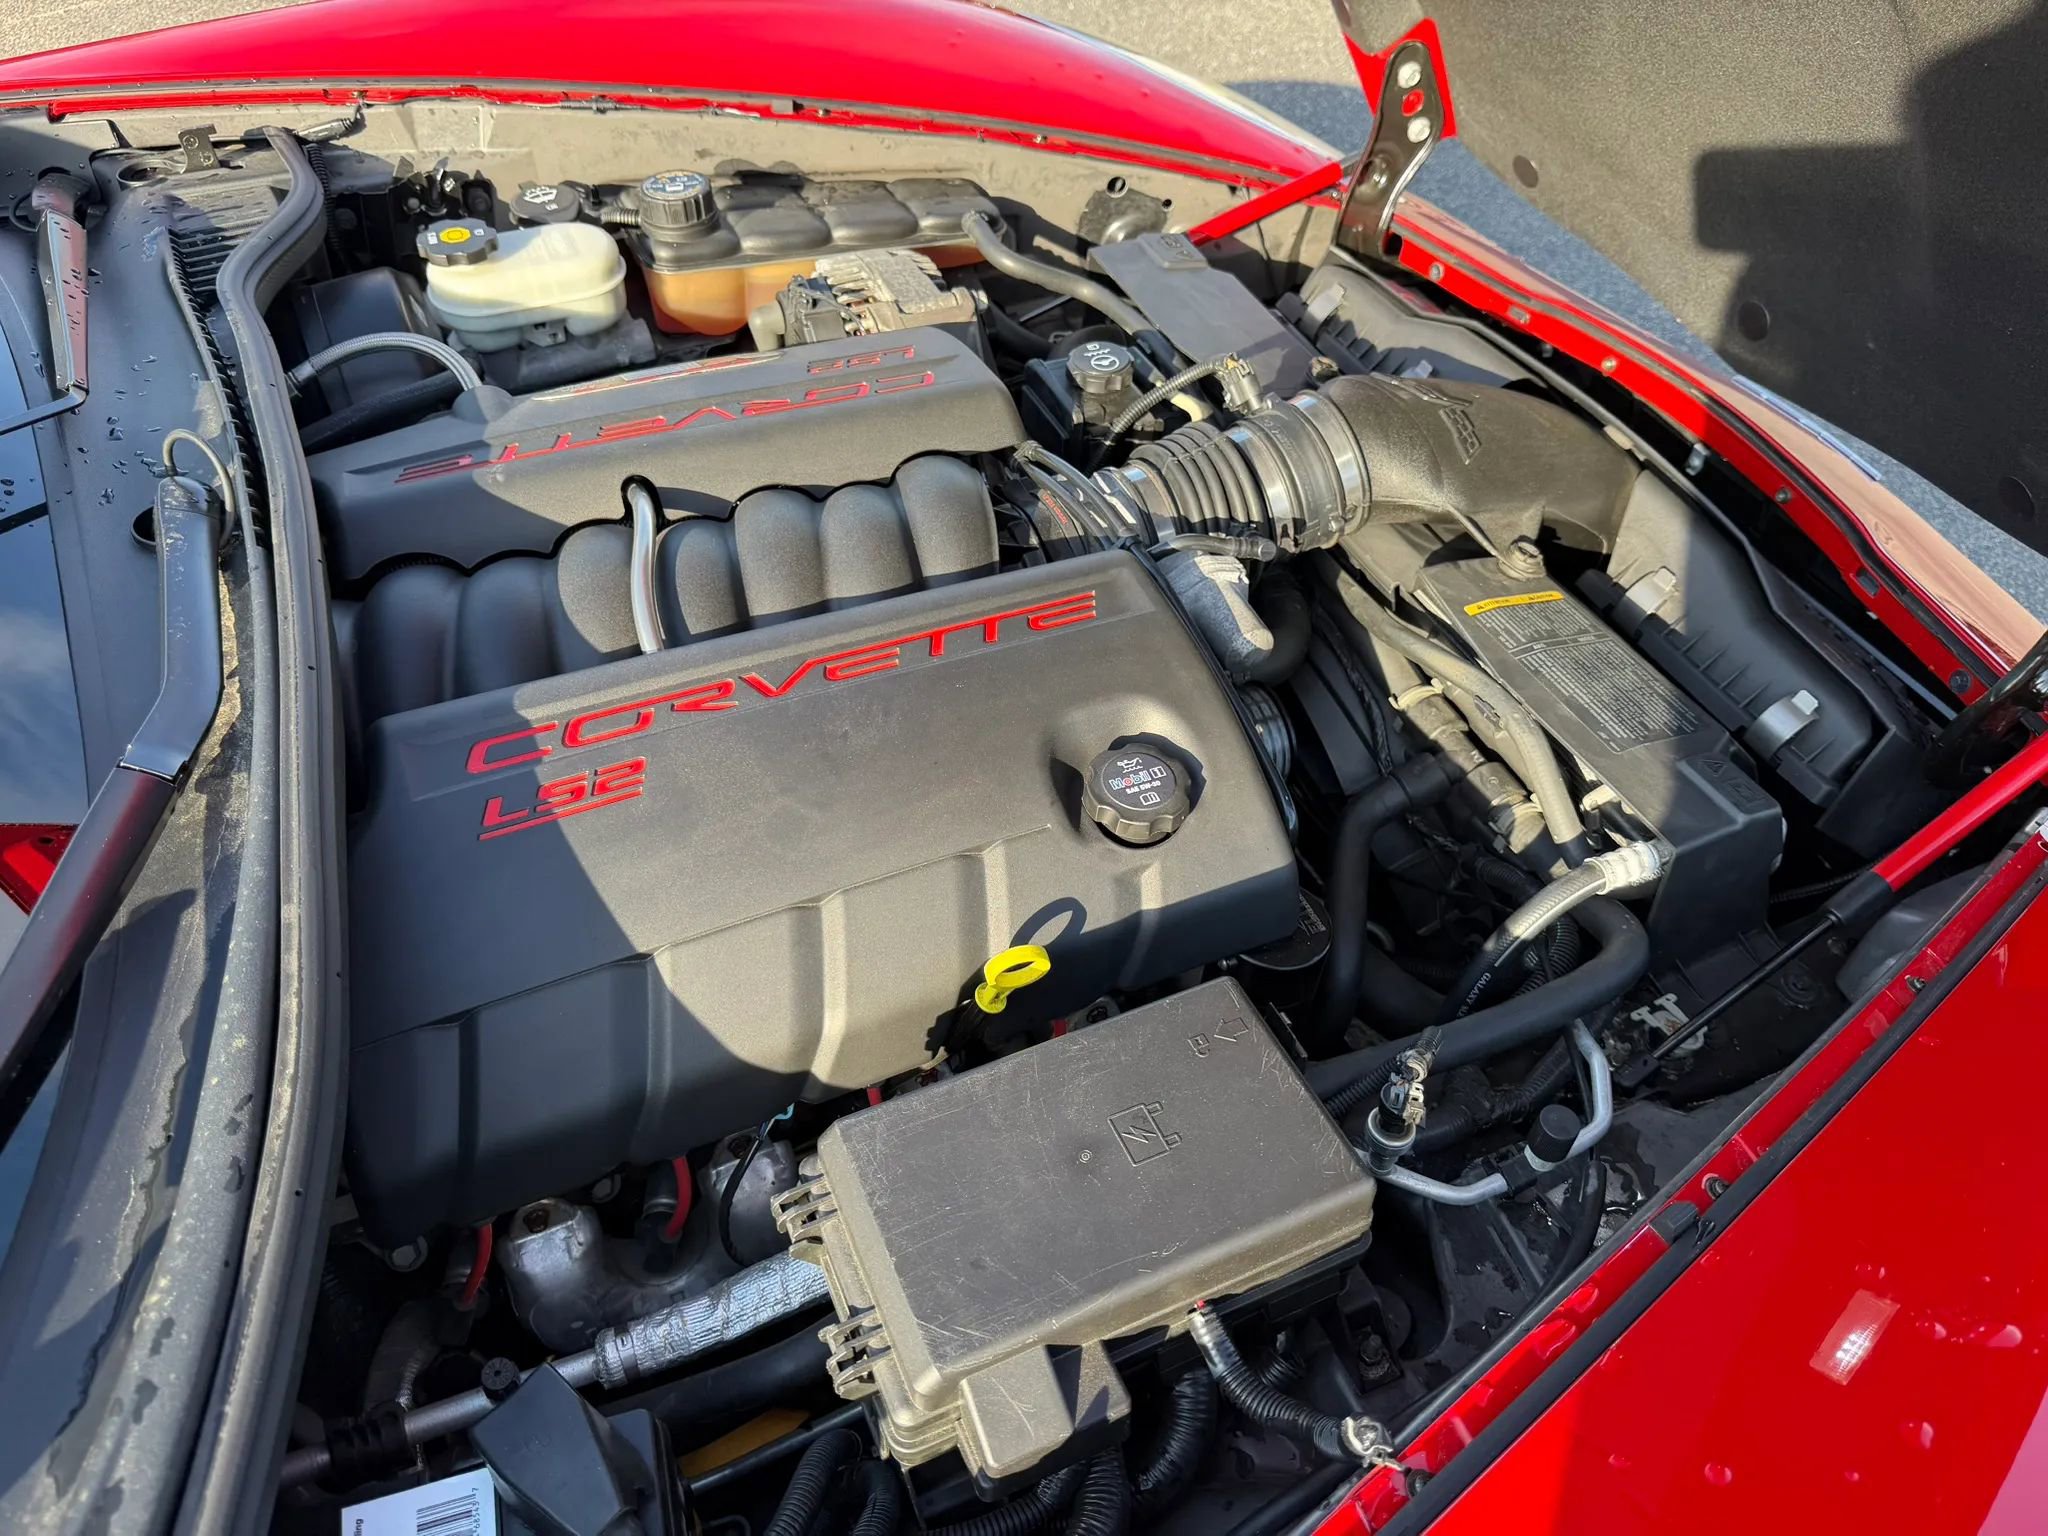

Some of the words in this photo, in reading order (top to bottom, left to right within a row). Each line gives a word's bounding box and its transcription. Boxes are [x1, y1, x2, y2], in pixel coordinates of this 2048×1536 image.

[394, 371, 934, 484] CORVETTE
[467, 590, 1097, 774] CORVETTE
[481, 756, 647, 828] LS2
[1109, 770, 1151, 790] Mobil
[1466, 972, 1492, 1005] GALAXY
